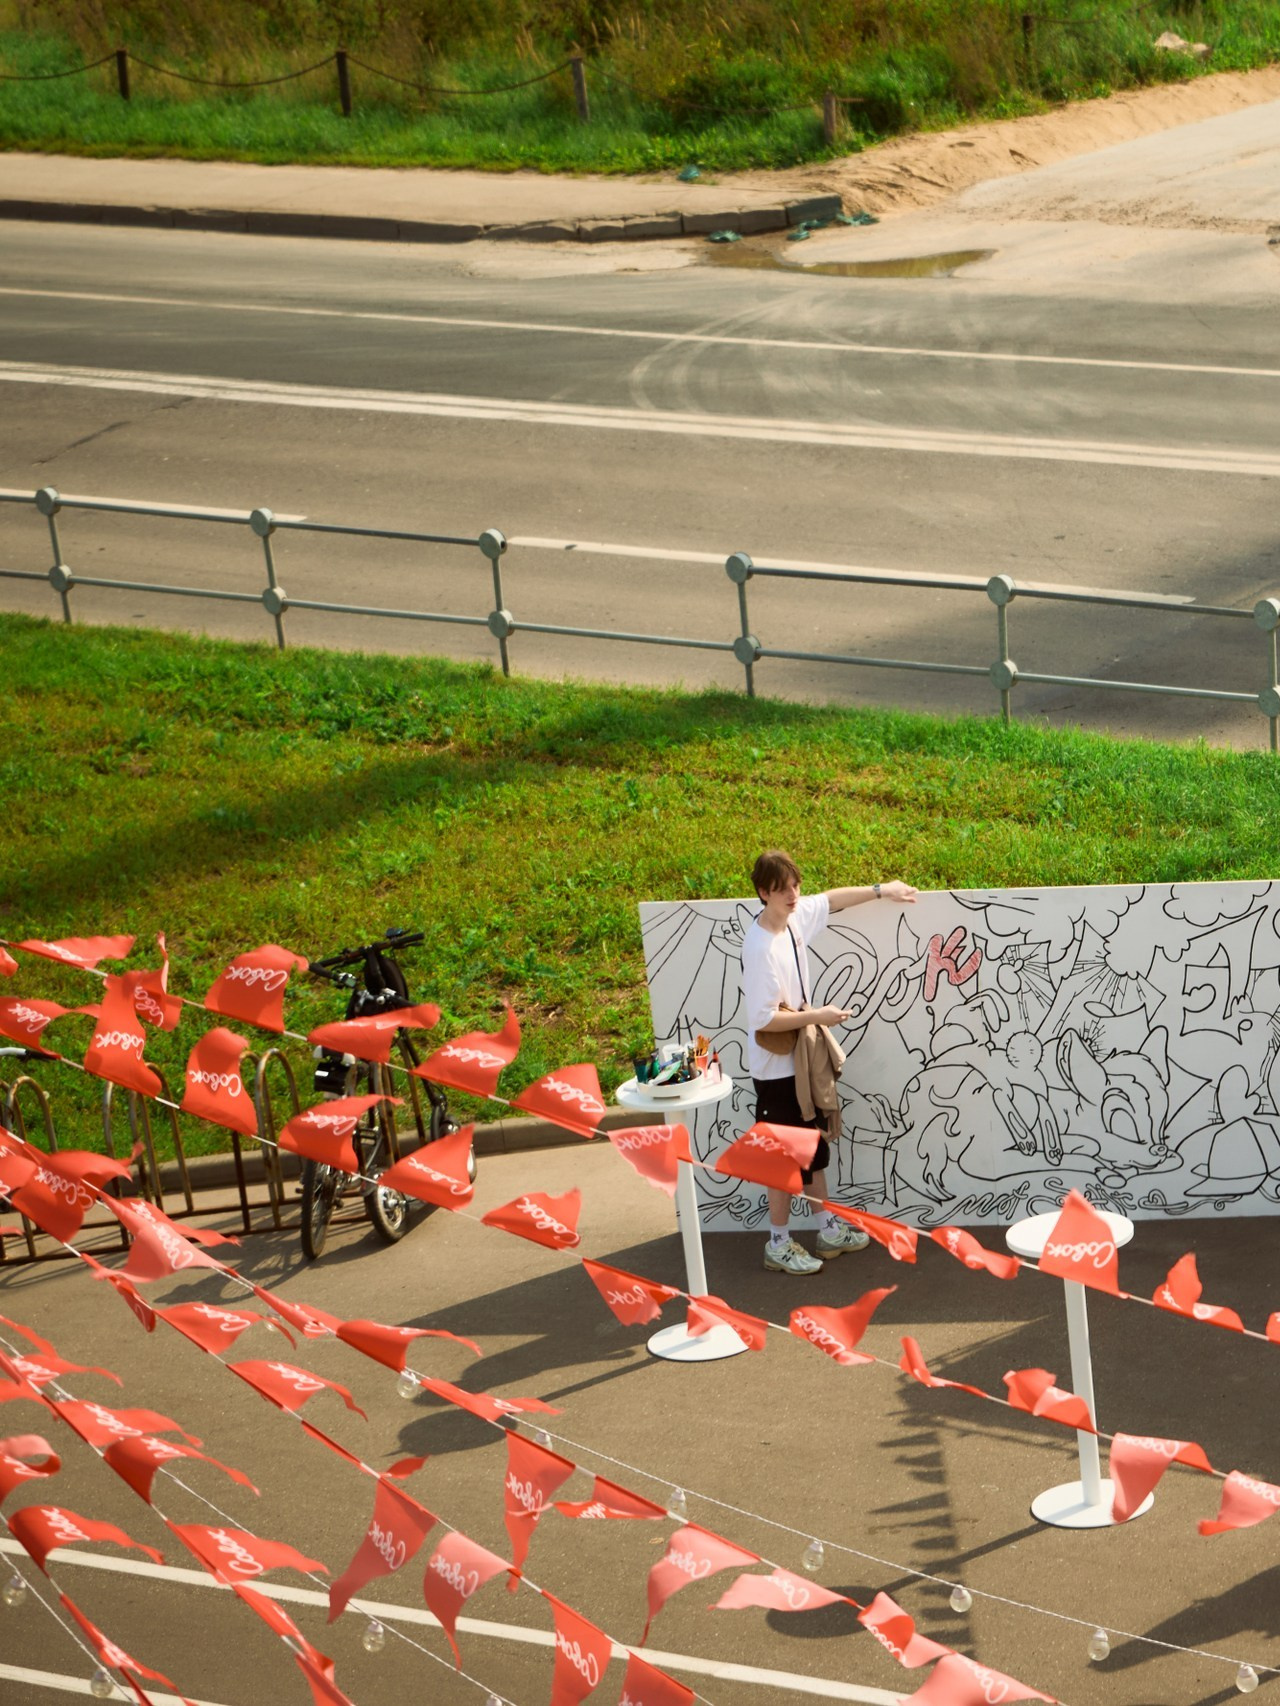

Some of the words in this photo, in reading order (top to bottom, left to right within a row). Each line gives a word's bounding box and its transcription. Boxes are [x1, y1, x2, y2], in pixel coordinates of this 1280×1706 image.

[225, 966, 289, 991] Совок
[189, 1070, 242, 1098] Совок
[541, 1077, 605, 1113] Совок
[1047, 1240, 1115, 1269] Совок
